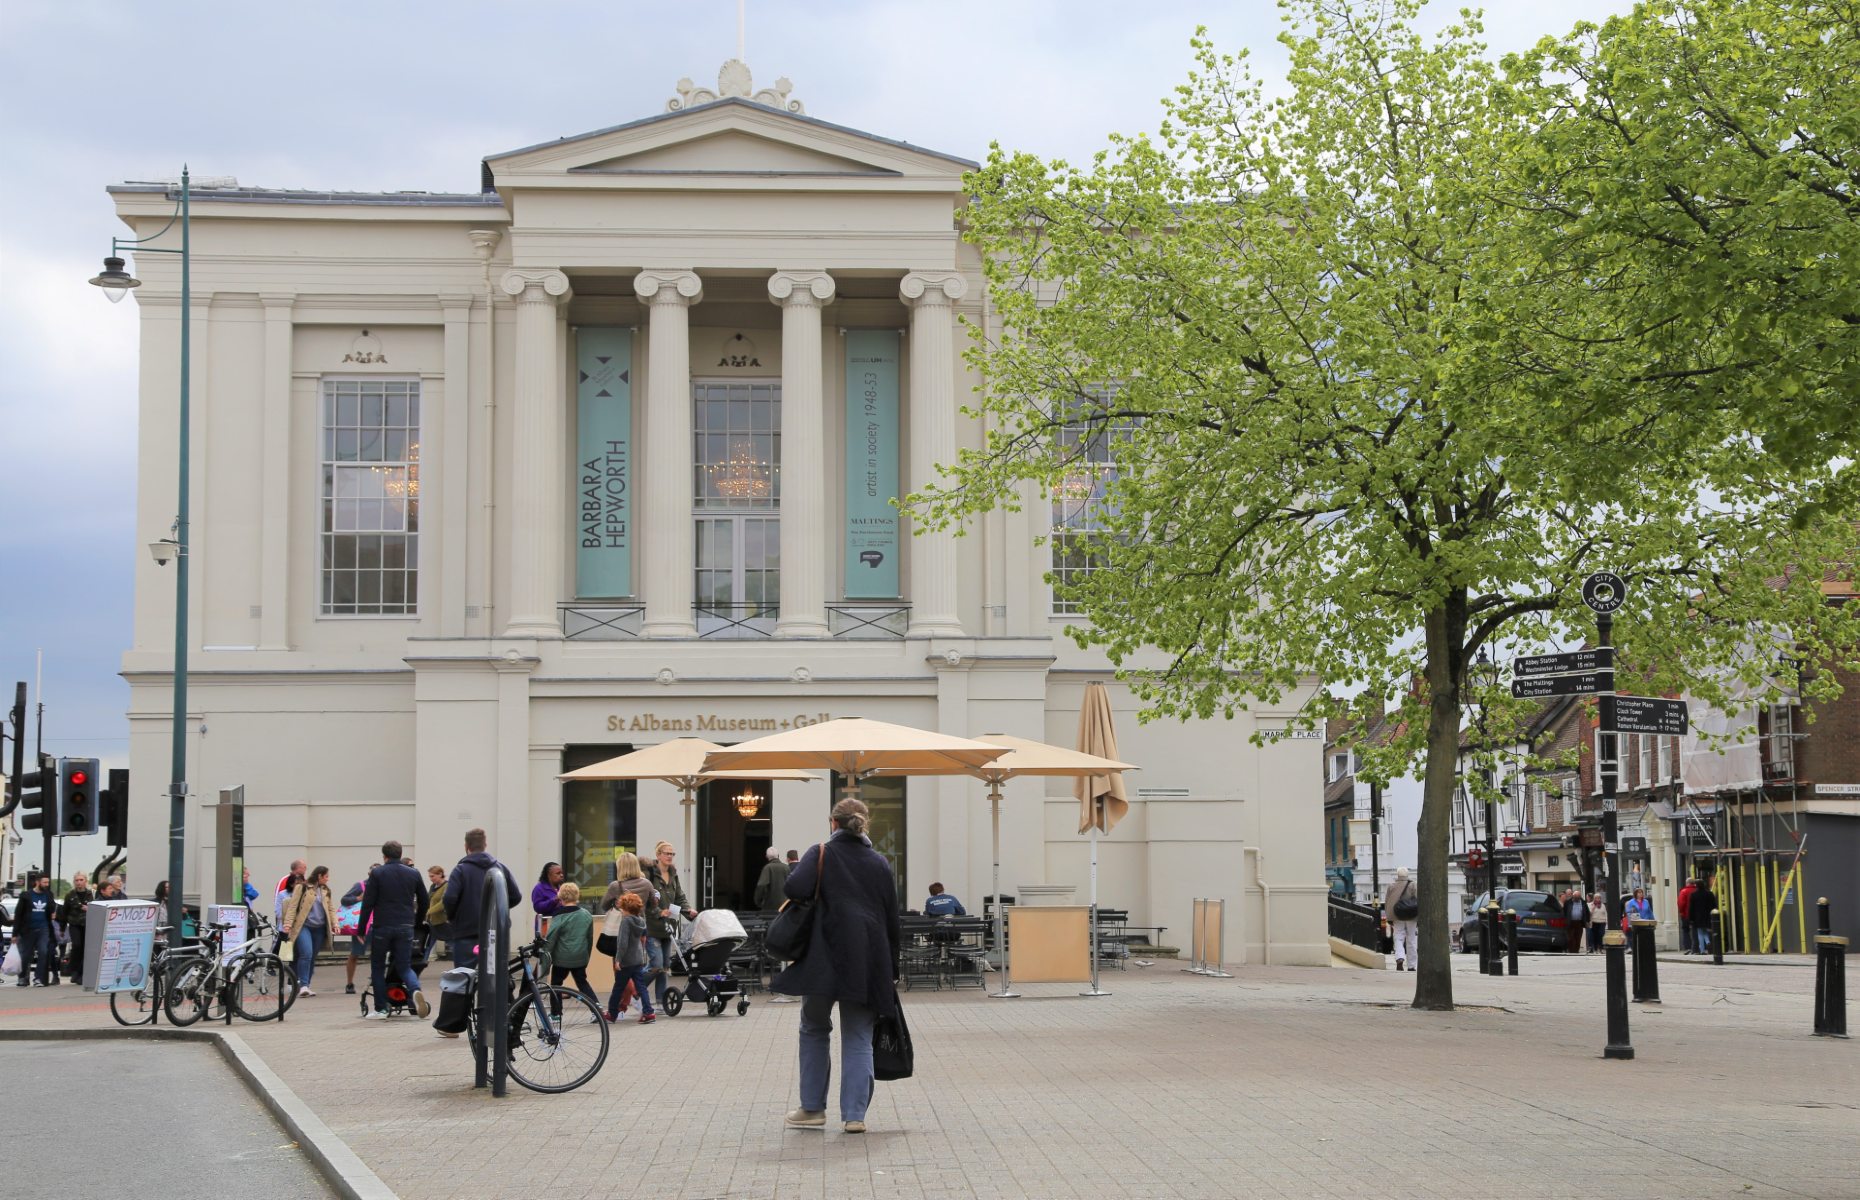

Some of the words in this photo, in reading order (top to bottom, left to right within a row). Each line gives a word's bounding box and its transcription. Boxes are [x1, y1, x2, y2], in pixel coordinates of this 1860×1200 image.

[864, 372, 877, 416] 1948-53
[864, 421, 880, 456] society
[864, 459, 876, 468] in
[864, 471, 877, 497] artist
[582, 457, 601, 548] BARBARA
[606, 441, 625, 548] HEPWORTH
[1588, 597, 1620, 609] CENTRE
[1525, 658, 1539, 667] Abbey
[1525, 665, 1553, 673] Westminster
[1616, 700, 1641, 709] Christopher
[607, 715, 625, 731] St
[629, 714, 692, 731] Albans
[696, 715, 776, 731] Museum
[780, 717, 790, 730] +
